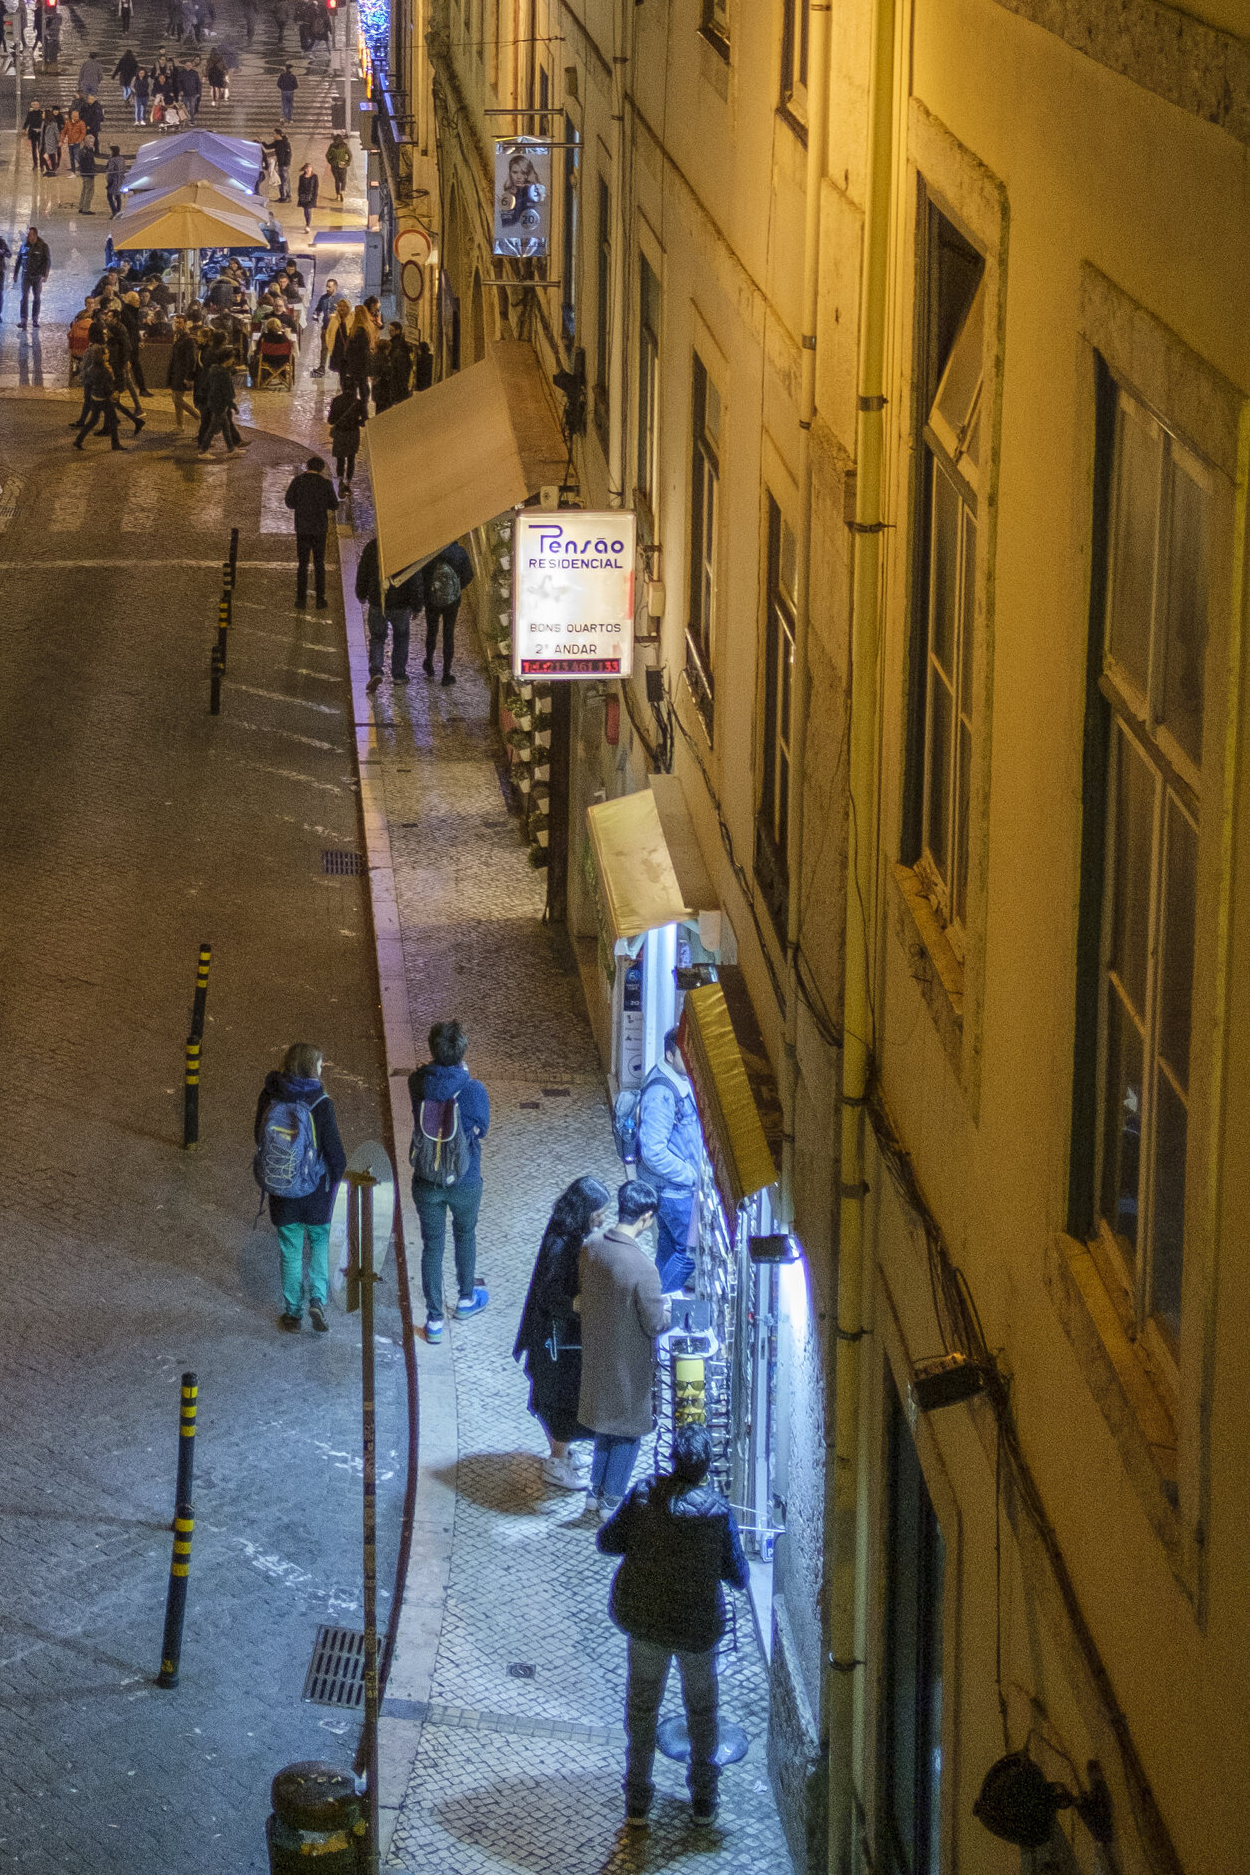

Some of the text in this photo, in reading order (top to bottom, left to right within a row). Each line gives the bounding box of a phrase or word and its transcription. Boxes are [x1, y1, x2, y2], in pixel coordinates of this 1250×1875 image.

[528, 524, 624, 554] Pensão
[528, 558, 623, 569] RESIDENCIAL
[530, 623, 561, 633] BONS
[554, 644, 598, 654] ANDAR
